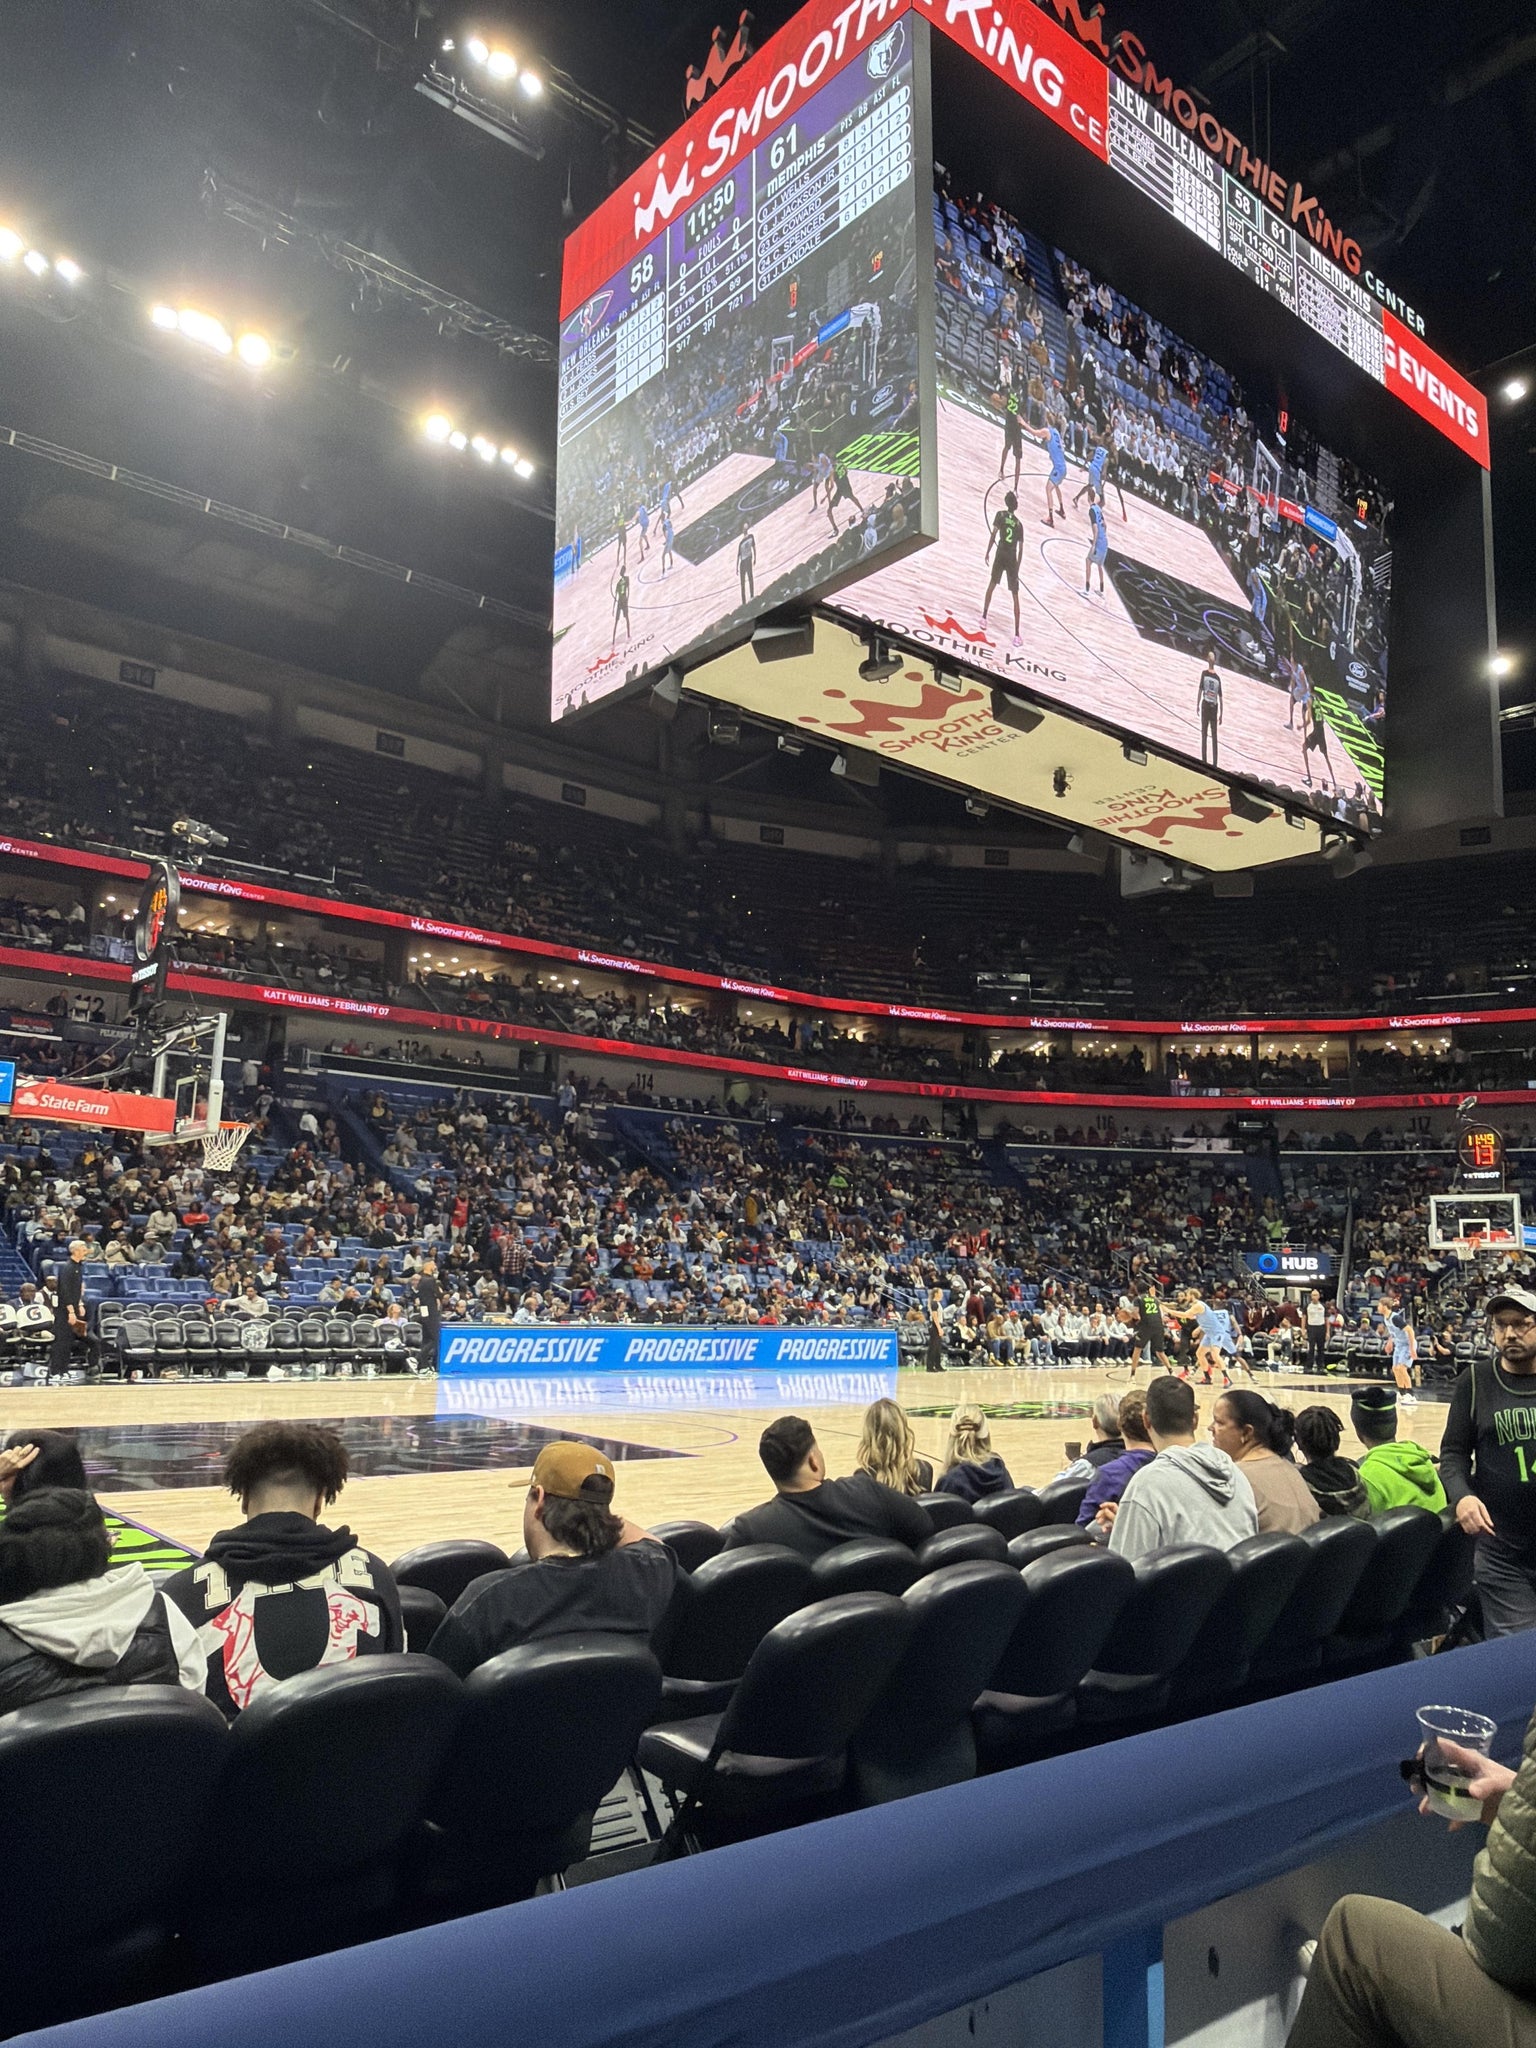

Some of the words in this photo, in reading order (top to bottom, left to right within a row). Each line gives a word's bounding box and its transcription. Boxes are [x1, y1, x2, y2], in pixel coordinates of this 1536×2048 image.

[702, 0, 932, 177] SMOOTH
[1069, 103, 1108, 147] CE
[840, 117, 853, 133] PTS
[858, 102, 869, 118] RB
[873, 85, 886, 105] AST
[891, 74, 901, 90] FL
[1116, 77, 1148, 124] NEW
[1153, 110, 1214, 182] ORLEANS
[770, 122, 797, 170] 61
[767, 135, 826, 198] MEMPHIS
[780, 171, 811, 203] WELLS
[780, 181, 821, 222] JACKSON
[823, 168, 838, 185] JR.
[843, 155, 852, 168] 12
[1113, 31, 1287, 211] SMOOTHIE
[1365, 270, 1426, 337] CENTER
[687, 179, 734, 236] 11:50
[1235, 189, 1251, 215] 58
[760, 240, 771, 252] 23
[782, 197, 822, 235] COWARD
[1271, 221, 1285, 245] 61
[679, 262, 687, 279] 0
[698, 234, 721, 260] FOULS
[733, 217, 740, 233] 0
[760, 258, 771, 270] 24
[783, 211, 826, 251] SPENCER
[1247, 230, 1274, 261] 11:50
[679, 280, 687, 296] 5
[732, 235, 740, 252] 4
[761, 274, 771, 287] 31
[782, 231, 822, 271] LANDALE
[630, 253, 654, 293] 58
[701, 277, 718, 296] FG%
[725, 251, 748, 276] 51.1%
[1310, 246, 1371, 313] MEMPHIS
[705, 297, 714, 313] FT
[702, 315, 716, 336] 3PT
[561, 353, 577, 375] NEW
[578, 323, 610, 359] ORLEANS
[1399, 346, 1479, 438] EVENTS
[1005, 527, 1013, 543] 2
[879, 706, 993, 753] SMOOTH
[956, 732, 1022, 758] CENTER
[1093, 784, 1157, 805] CENTER
[1093, 787, 1226, 827] SMOOTHIE
[11, 847, 39, 857] CENTER
[179, 877, 219, 892] MOOTHIE
[425, 922, 465, 938] SMOOTHIE
[591, 954, 624, 969] SMOOTHIE
[730, 982, 760, 995] SMOOTHIE
[263, 990, 288, 1000] KATT
[288, 993, 330, 1008] WILLIAMS
[335, 1001, 378, 1014] FEBRUARY
[378, 1008, 390, 1016] 07
[900, 1008, 932, 1019] SMOOTHIE
[1042, 1020, 1076, 1029] SMOOTHIE
[1194, 1024, 1229, 1032] SMOOTHIE
[1403, 1017, 1442, 1027] SMOOTHIE
[636, 1073, 654, 1091] 114
[787, 1070, 802, 1078] KATT
[802, 1072, 829, 1082] WILLIAMS
[831, 1076, 859, 1087] FEBRUARY
[1251, 1098, 1270, 1106] KATT
[1308, 1099, 1345, 1107] FEBRUARY
[1345, 1098, 1356, 1106] 07
[1468, 1134, 1495, 1146] 11:49
[1474, 1145, 1495, 1167] 13
[1281, 1256, 1319, 1270] HUB
[26, 1305, 42, 1321] G
[1145, 1303, 1159, 1314] 22
[444, 1337, 603, 1363] PROGRESSIVE
[624, 1338, 756, 1362] PROGRESSIVE
[775, 1338, 890, 1361] PROGRESSIVE
[1494, 1407, 1536, 1446] NO
